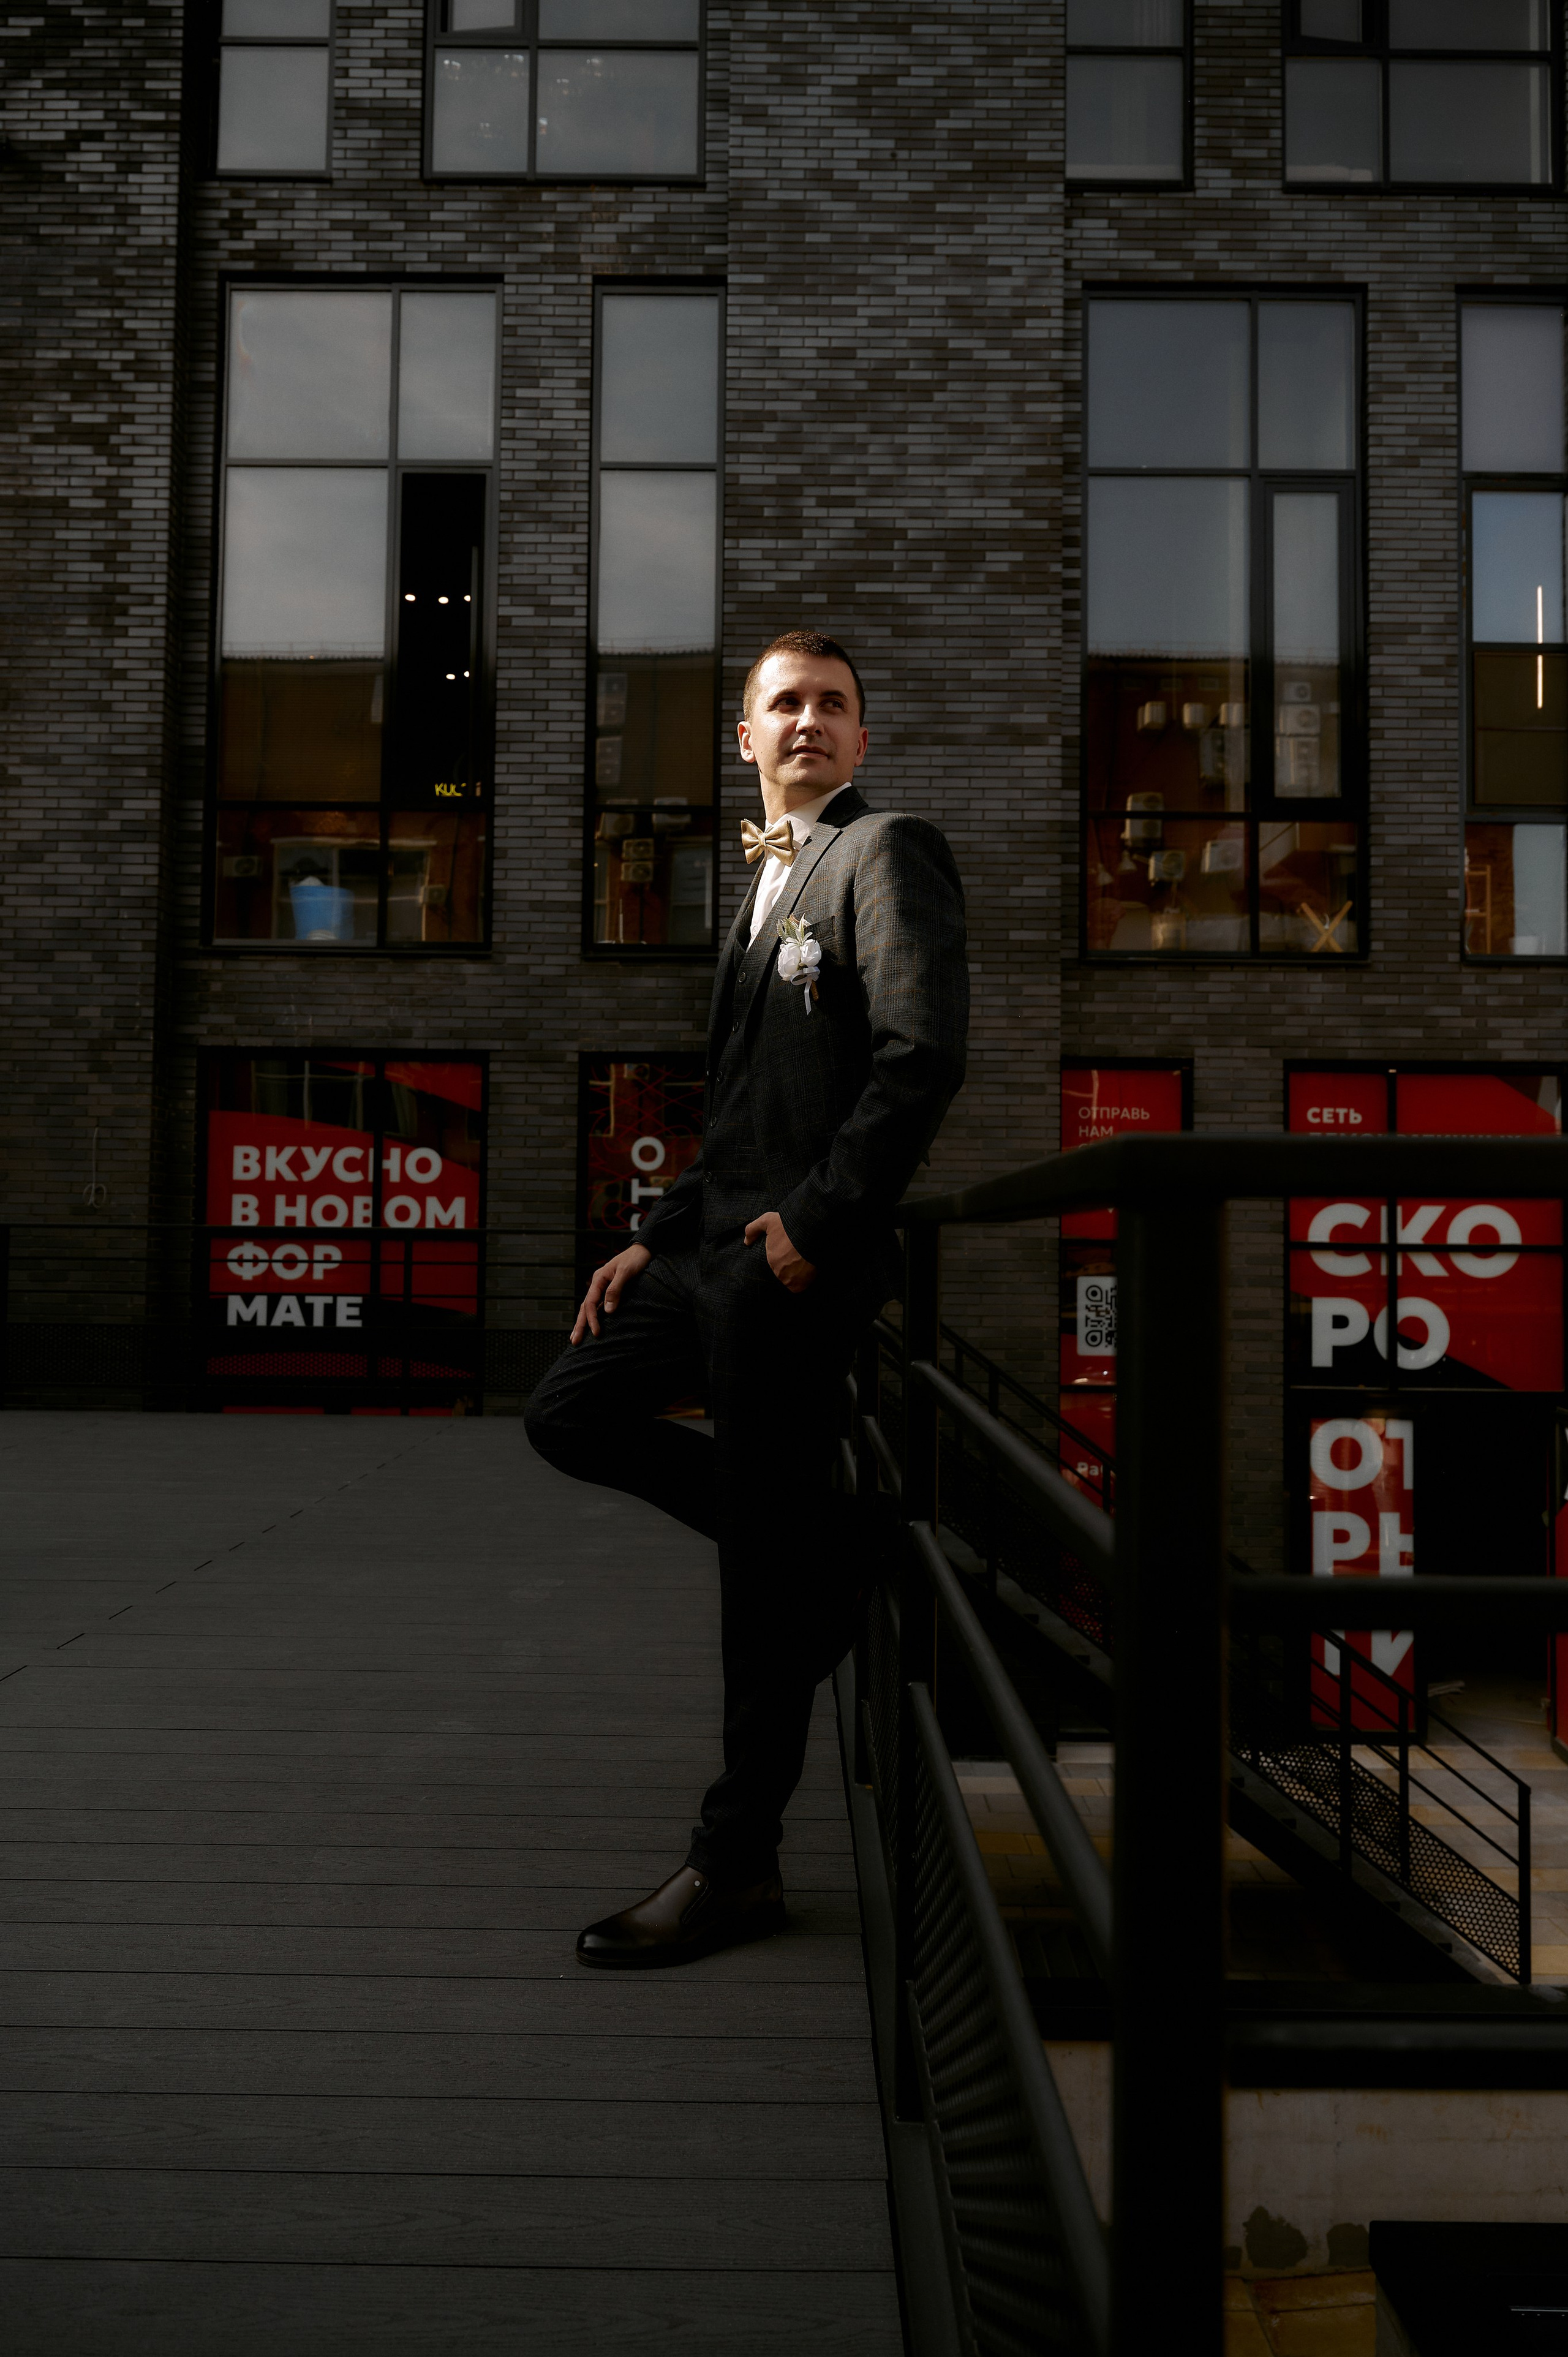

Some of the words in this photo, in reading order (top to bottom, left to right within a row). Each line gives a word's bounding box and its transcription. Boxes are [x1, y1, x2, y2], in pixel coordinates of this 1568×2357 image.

[1078, 1106, 1150, 1120] ОТПРАВЬ
[1078, 1125, 1114, 1137] НАМ
[1306, 1106, 1363, 1125] СЕТЬ
[232, 1144, 443, 1184] ВКУСНО
[230, 1193, 260, 1227] В
[274, 1193, 467, 1229] НОВОМ
[1306, 1202, 1523, 1280] СКО
[226, 1240, 343, 1281] ФОР
[226, 1294, 364, 1328] МАТЕ
[1310, 1295, 1451, 1371] РО
